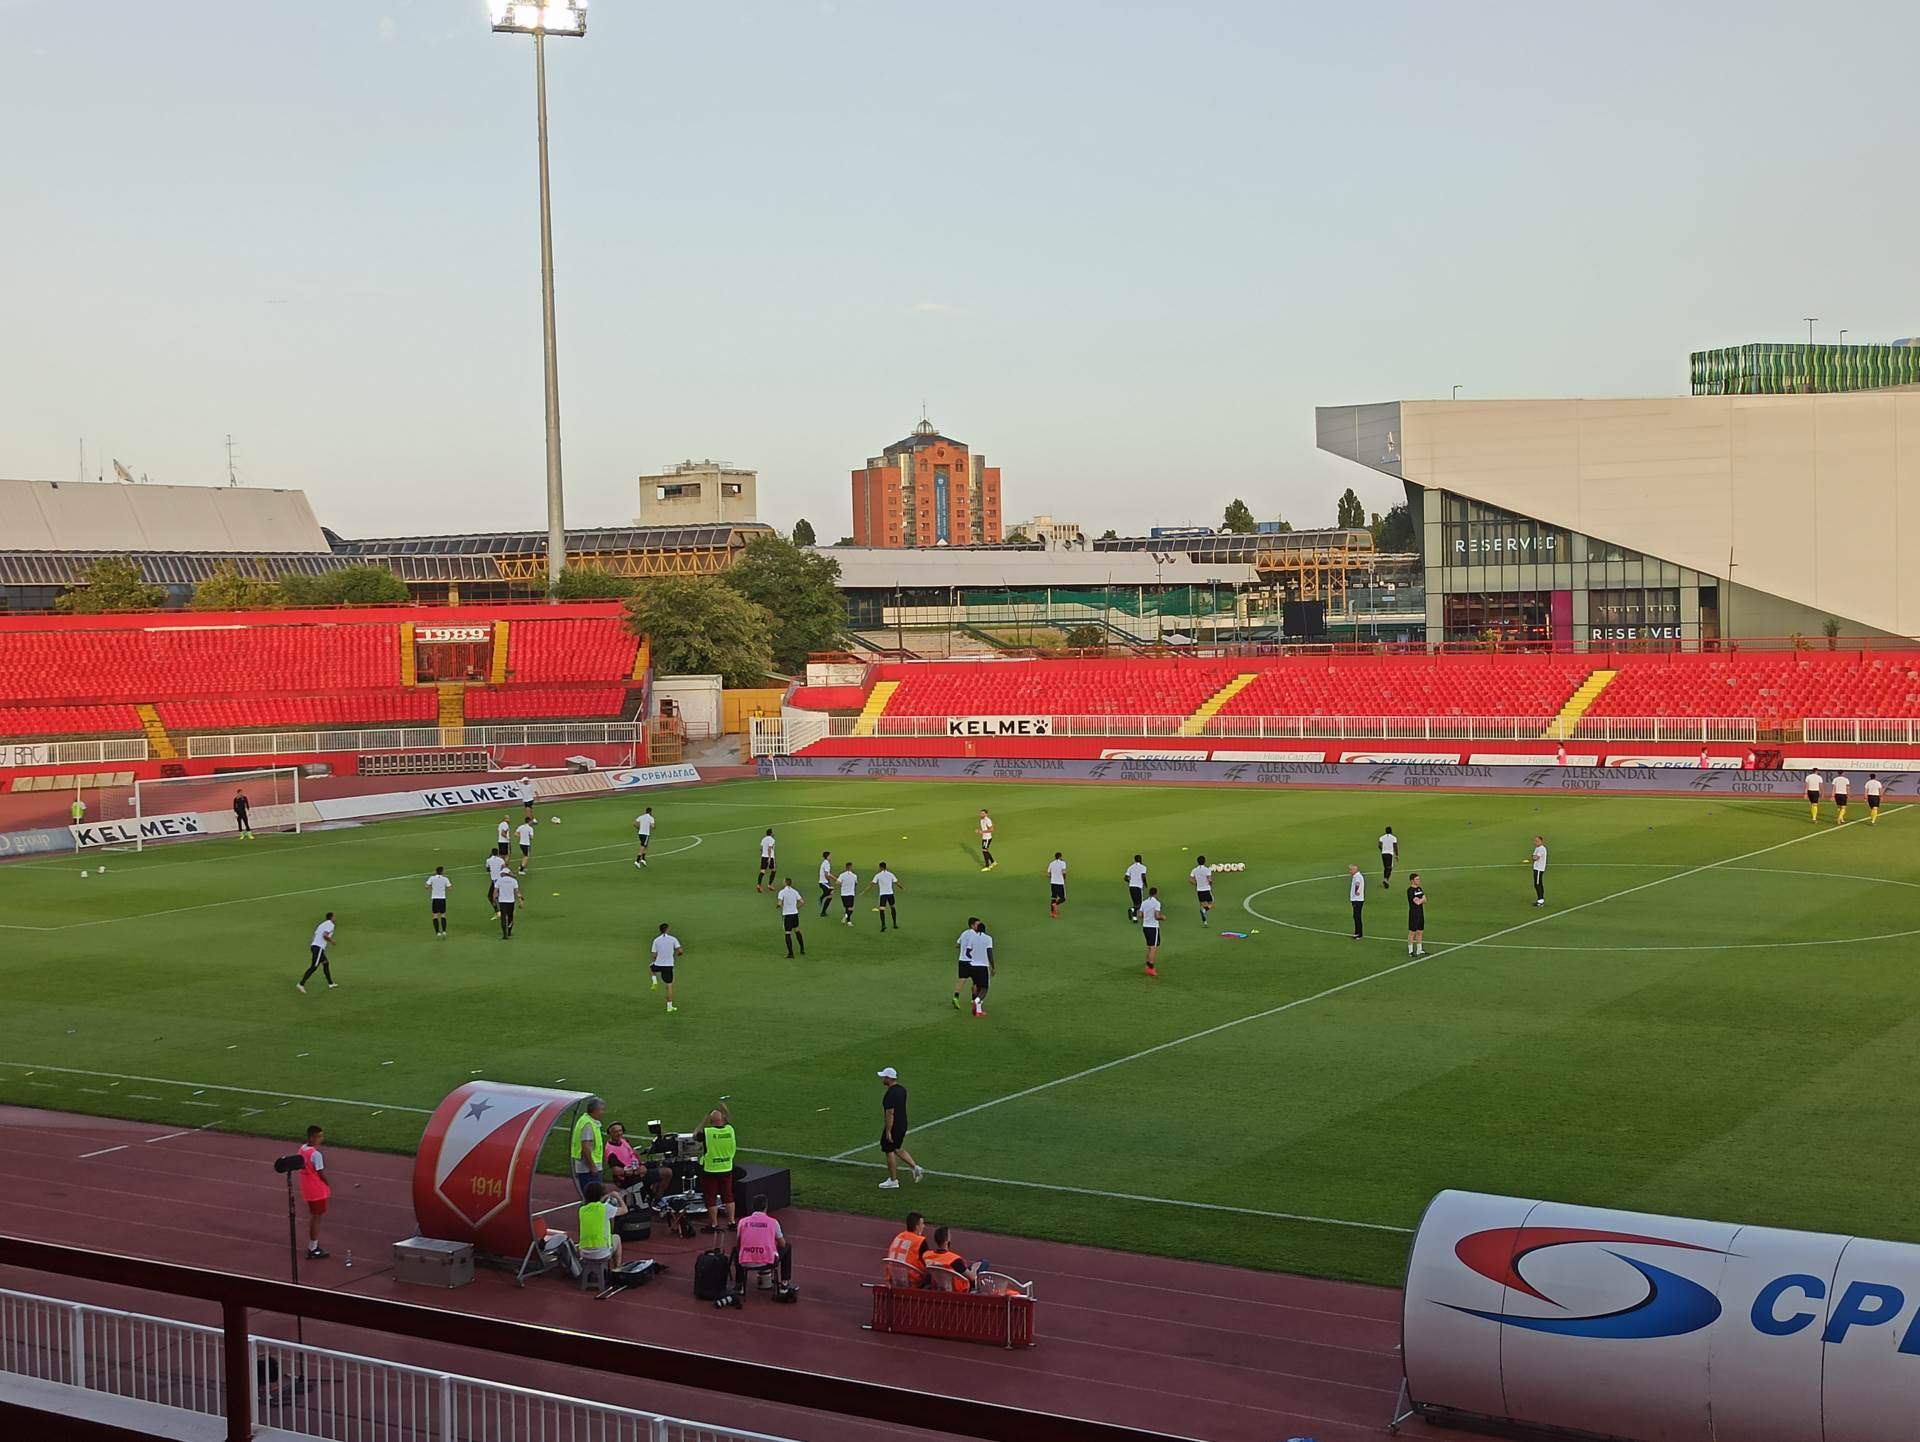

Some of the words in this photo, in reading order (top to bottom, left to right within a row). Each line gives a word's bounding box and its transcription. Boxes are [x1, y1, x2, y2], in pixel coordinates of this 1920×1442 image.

[1455, 536, 1556, 552] RESERVED
[424, 629, 484, 641] 1989
[1592, 627, 1681, 640] RESEVED
[949, 720, 1030, 735] KELME
[867, 758, 940, 768] ALEKSANDAR
[993, 759, 1065, 770] ALEKSANDAR
[1120, 760, 1197, 772] ALEKSANDAR
[1256, 762, 1340, 775] ALEKSANDAR
[867, 767, 898, 776] GROUP
[993, 769, 1023, 777] GROUP
[1120, 771, 1152, 780] GROUP
[1403, 765, 1493, 777] ALEKSANDAR
[1562, 767, 1658, 780] ALEKSANDAR
[1256, 774, 1291, 784] GROUP
[1403, 777, 1441, 787] GROUP
[1562, 780, 1601, 789] GROUP
[1731, 783, 1774, 793] GROUP
[424, 786, 505, 808] KELME
[77, 819, 180, 846] KELME
[15, 834, 50, 853] group
[470, 1175, 503, 1199] 1914
[1750, 1273, 1920, 1356] СР
